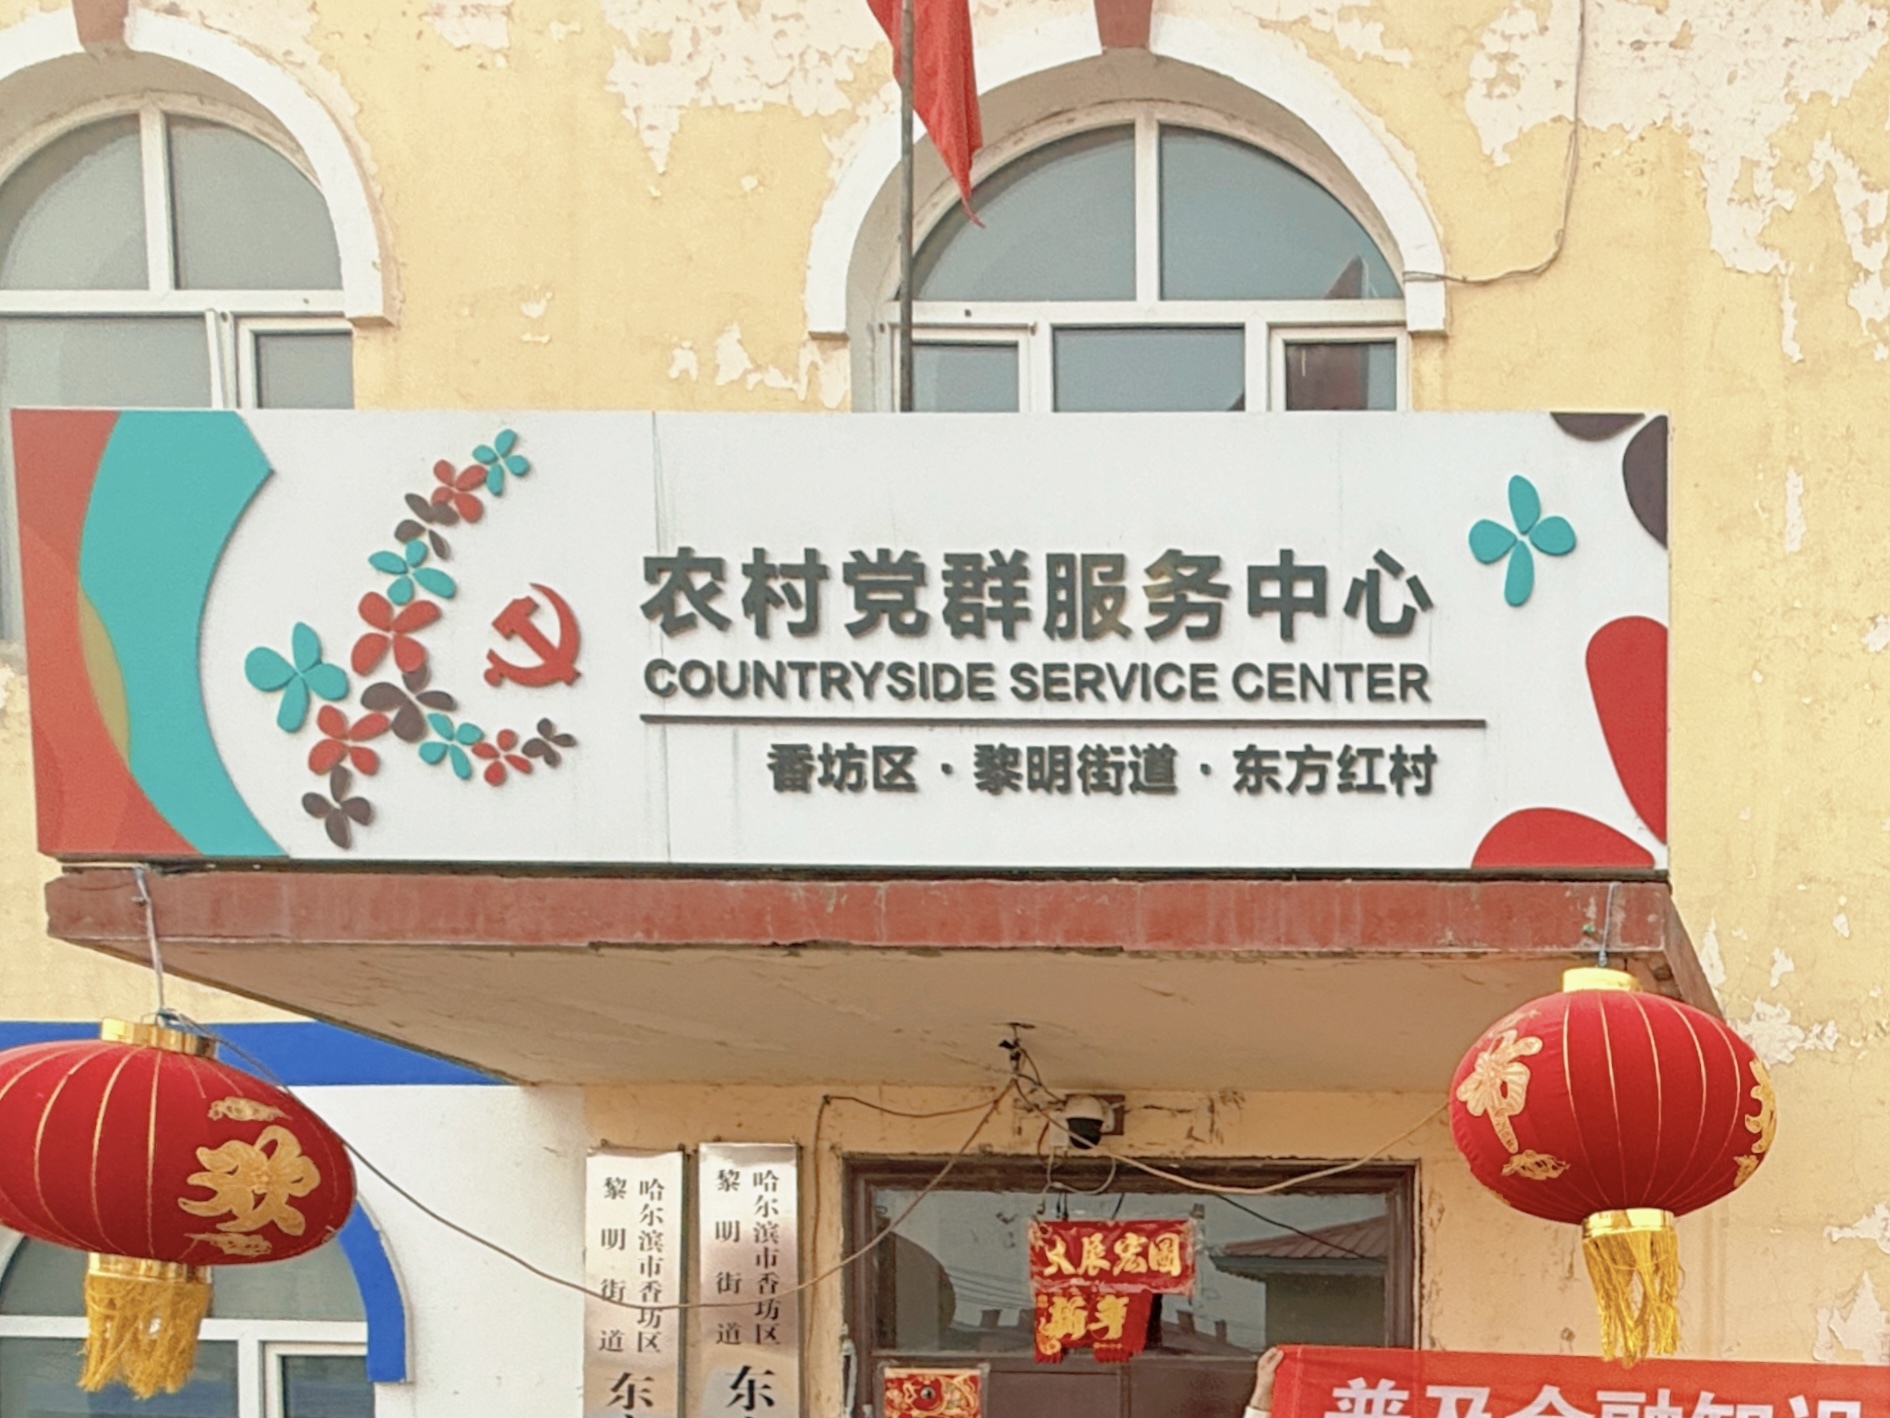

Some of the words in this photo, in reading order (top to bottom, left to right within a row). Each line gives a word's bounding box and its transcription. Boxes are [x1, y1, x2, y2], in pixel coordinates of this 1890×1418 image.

[639, 546, 1435, 642] 农村党群服务中心
[644, 658, 996, 701] COUNTRYSIDE
[1009, 661, 1219, 701] SERVICE
[1231, 661, 1433, 702] CENTER
[599, 1177, 628, 1352] 黎明街道
[637, 1178, 665, 1353] 哈尔滨市香坊区
[715, 1169, 742, 1346] 黎明街道
[753, 1169, 781, 1346] 哈尔滨市香坊区
